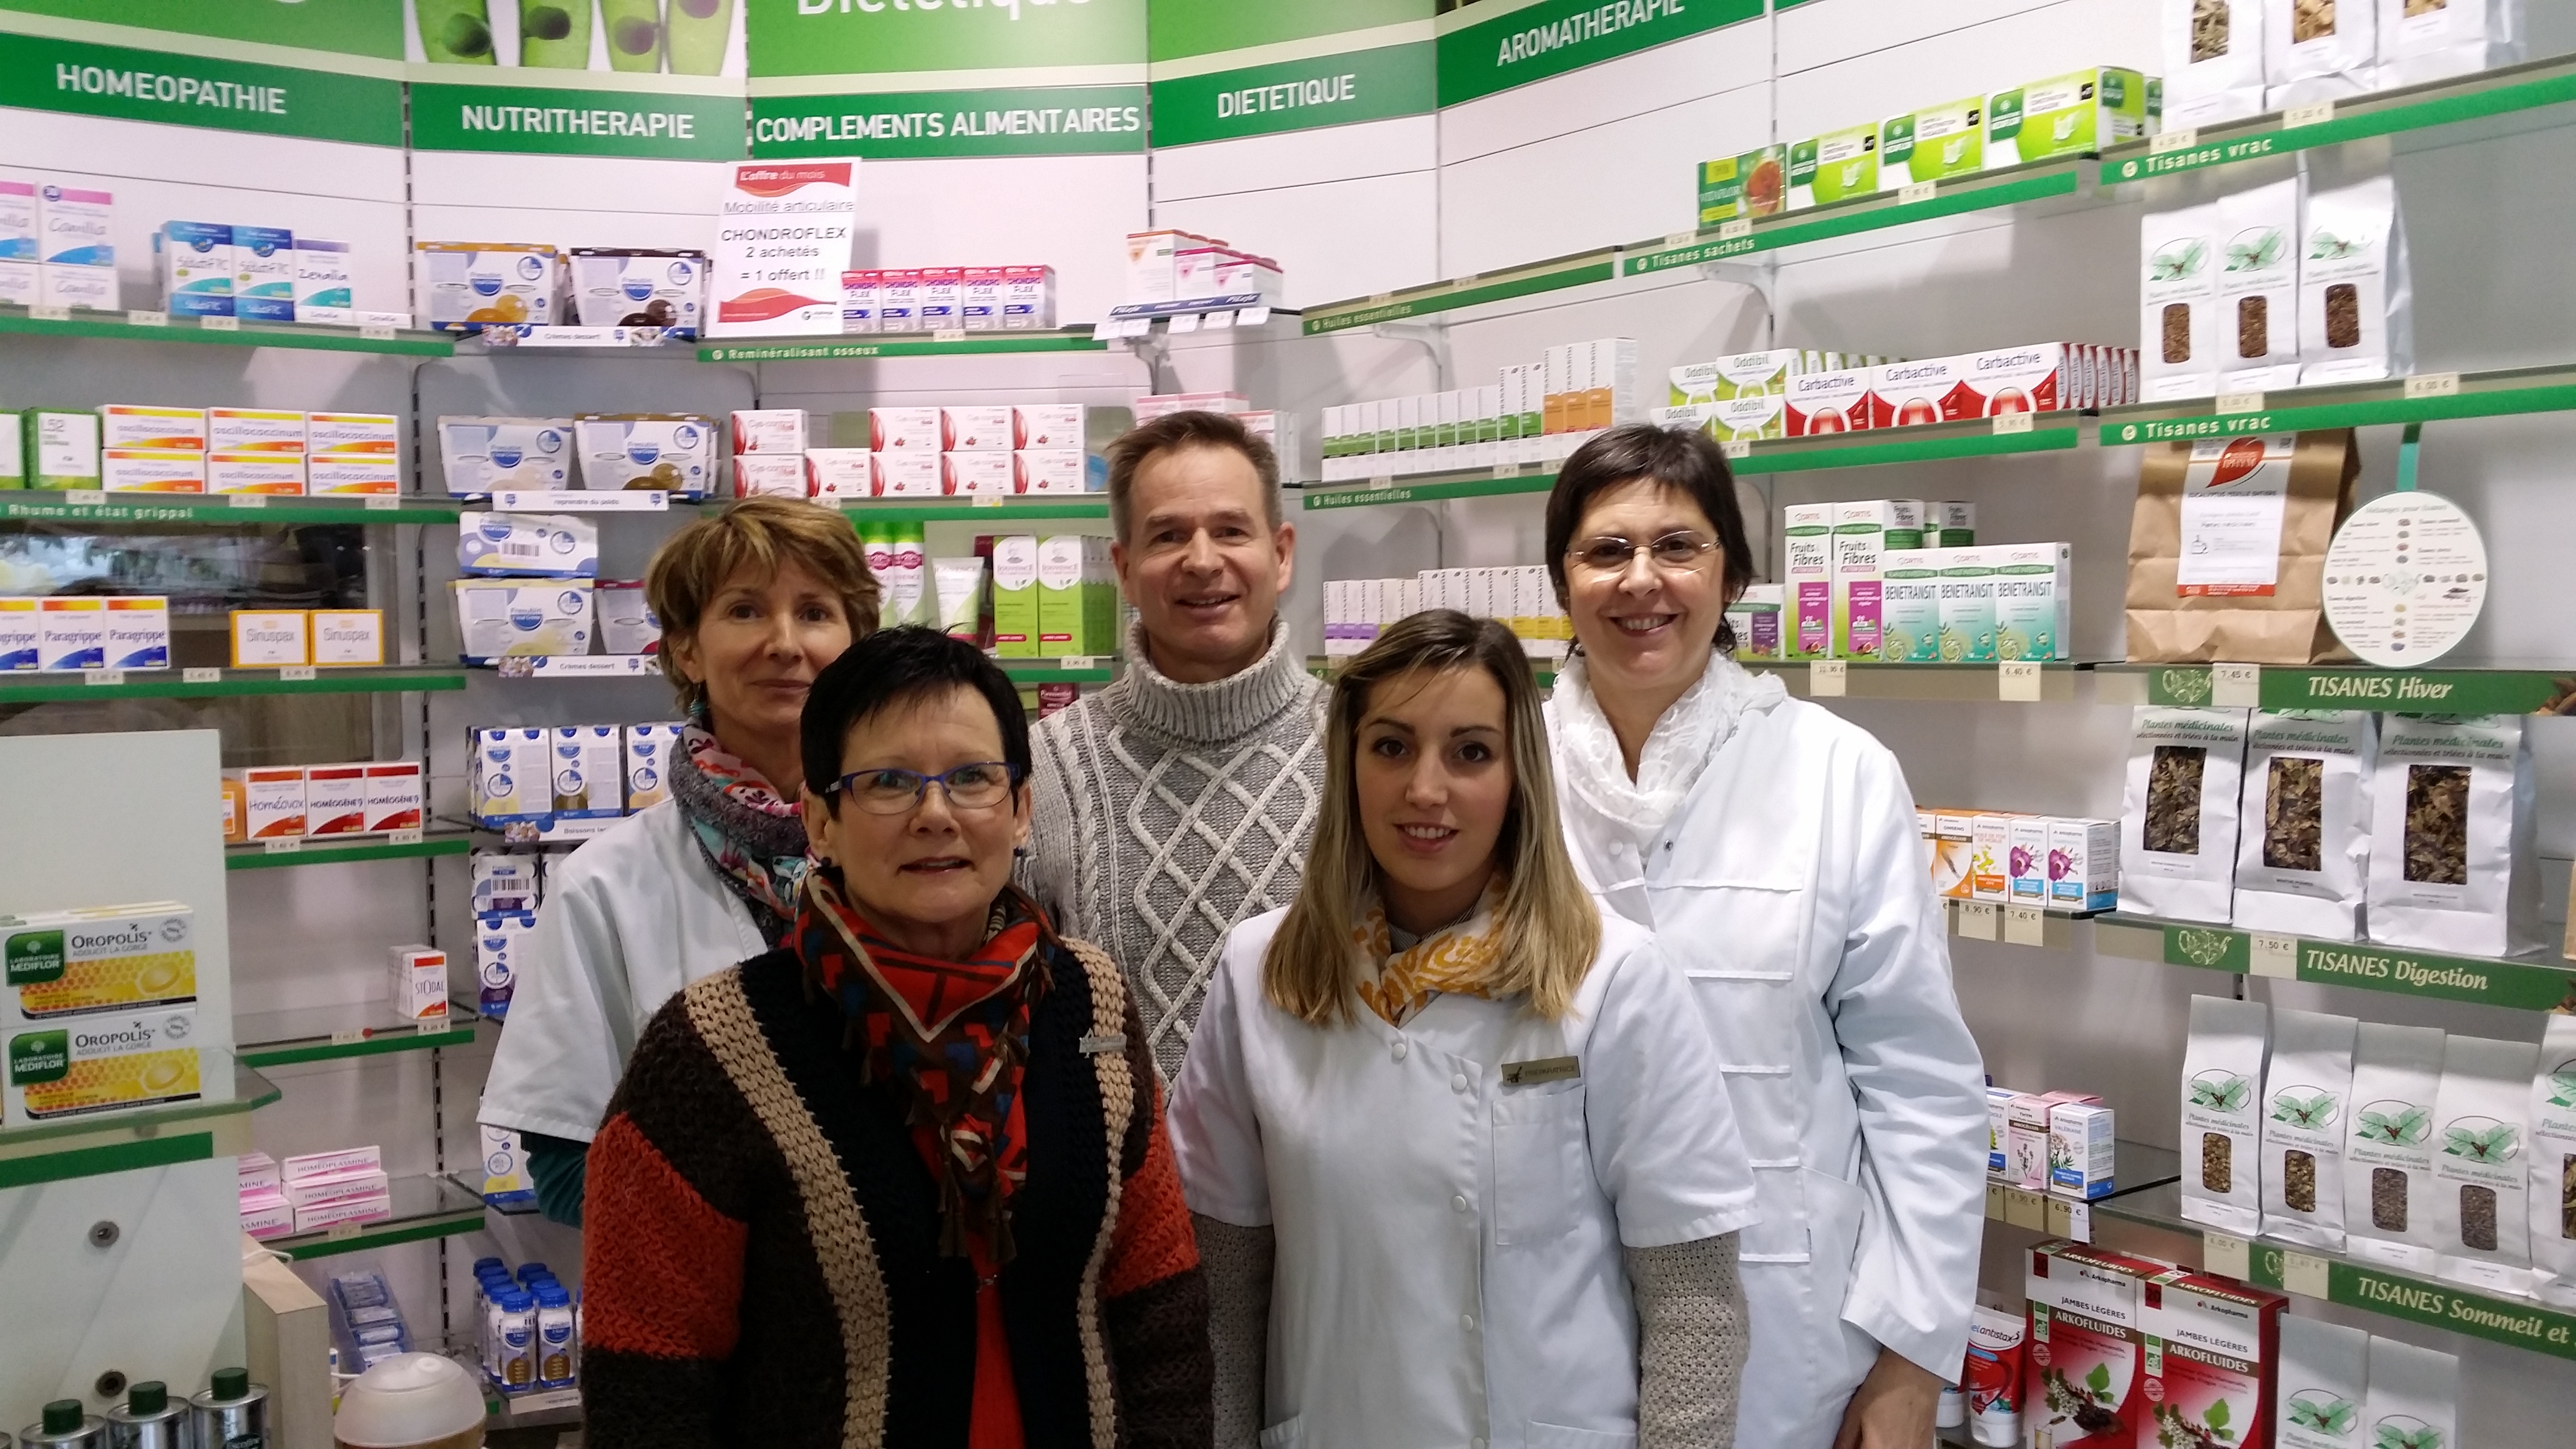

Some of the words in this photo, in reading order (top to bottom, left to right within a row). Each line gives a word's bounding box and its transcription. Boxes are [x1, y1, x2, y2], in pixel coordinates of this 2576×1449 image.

[1498, 0, 1685, 66] AROMATHERAPIE
[57, 63, 287, 115] HOMEOPATHIE
[1217, 74, 1357, 119] DIETETIQUE
[462, 105, 695, 139] NUTRITHERAPIE
[756, 112, 945, 143] COMPLEMENTS
[950, 106, 1141, 137] ALIMENTAIRES
[2146, 147, 2221, 173] Tisanes
[2228, 139, 2272, 157] vrac
[780, 170, 794, 180] du
[796, 169, 826, 180] mois
[723, 201, 779, 214] Mobilité
[783, 200, 855, 212] articulaire
[721, 227, 847, 242] CHONDROFLEX
[745, 246, 755, 258] 2
[759, 245, 821, 258] achetés
[1652, 249, 1700, 268] Tisanes
[1703, 238, 1755, 259] sachets
[756, 270, 763, 281] 1
[768, 269, 809, 281] offert
[832, 345, 879, 358] osseux
[1977, 351, 2041, 371] Carbactive
[1885, 363, 1947, 382] Carbactive
[1798, 375, 1856, 393] Carbactive
[2146, 416, 2220, 439] Tisanes
[2228, 414, 2271, 432] vrac
[1323, 494, 1352, 506] Huiles
[1354, 489, 1412, 503] essentielles
[8, 504, 67, 517] Rhume
[72, 506, 90, 517] et
[95, 503, 129, 517] état
[134, 507, 194, 520] grippal
[1790, 542, 1815, 554] Fruits
[1839, 540, 1866, 552] Fruits
[1793, 554, 1824, 566] Fibres
[1842, 553, 1876, 565] Fibres
[1885, 585, 1936, 600] BENETRANSIT
[1941, 583, 1994, 599] BENETRANSIT
[1998, 582, 2052, 597] BENETRANSIT
[44, 630, 102, 645] Paragrippe
[109, 628, 166, 643] Paragrippe
[246, 628, 295, 643] Sinuspax
[324, 627, 369, 643] Sinuspax
[2245, 671, 2251, 679] €
[2309, 676, 2394, 700] TISANES
[2398, 676, 2453, 700] Hiver
[2142, 720, 2173, 730] Plantes
[2174, 719, 2234, 732] médicinales
[2253, 729, 2285, 740] Plantes
[2286, 731, 2349, 744] médicinales
[2393, 734, 2429, 746] Plantes
[2433, 736, 2504, 749] médicinales
[249, 796, 305, 811] Homéovox
[1965, 905, 1982, 914] 8.90
[2010, 910, 2027, 920] 7.40
[2282, 942, 2289, 952] €
[2307, 950, 2389, 978] TISANES
[2394, 959, 2488, 991] Digestion
[2188, 1113, 2210, 1123] Plantes
[2210, 1118, 2250, 1131] médicinales
[2269, 1130, 2293, 1141] Plantes
[2354, 1148, 2383, 1158] Plantes
[2383, 1153, 2431, 1164] médicinales
[2442, 1164, 2471, 1176] Plantes
[2472, 1170, 2518, 1183] médicinales
[2055, 1203, 2072, 1214] 6.90
[2062, 1252, 2135, 1274] ARKOFLUIDES
[2091, 1273, 2127, 1287] Arkopharma
[2177, 1282, 2258, 1305] ARKOFLUIDES
[2061, 1296, 2090, 1310] JAMBES
[2091, 1304, 2126, 1320] LÉGÈRES
[2210, 1305, 2249, 1319] Arkopharma
[2358, 1276, 2444, 1314] TISANES
[2448, 1298, 2542, 1338] Sommeil
[2547, 1326, 2570, 1344] et
[2055, 1311, 2127, 1339] ARKOFLUIDES
[2177, 1329, 2208, 1343] JAMBES
[2210, 1338, 2248, 1354] LÉGÈRES
[2169, 1343, 2249, 1373] ARKOFLUIDES
